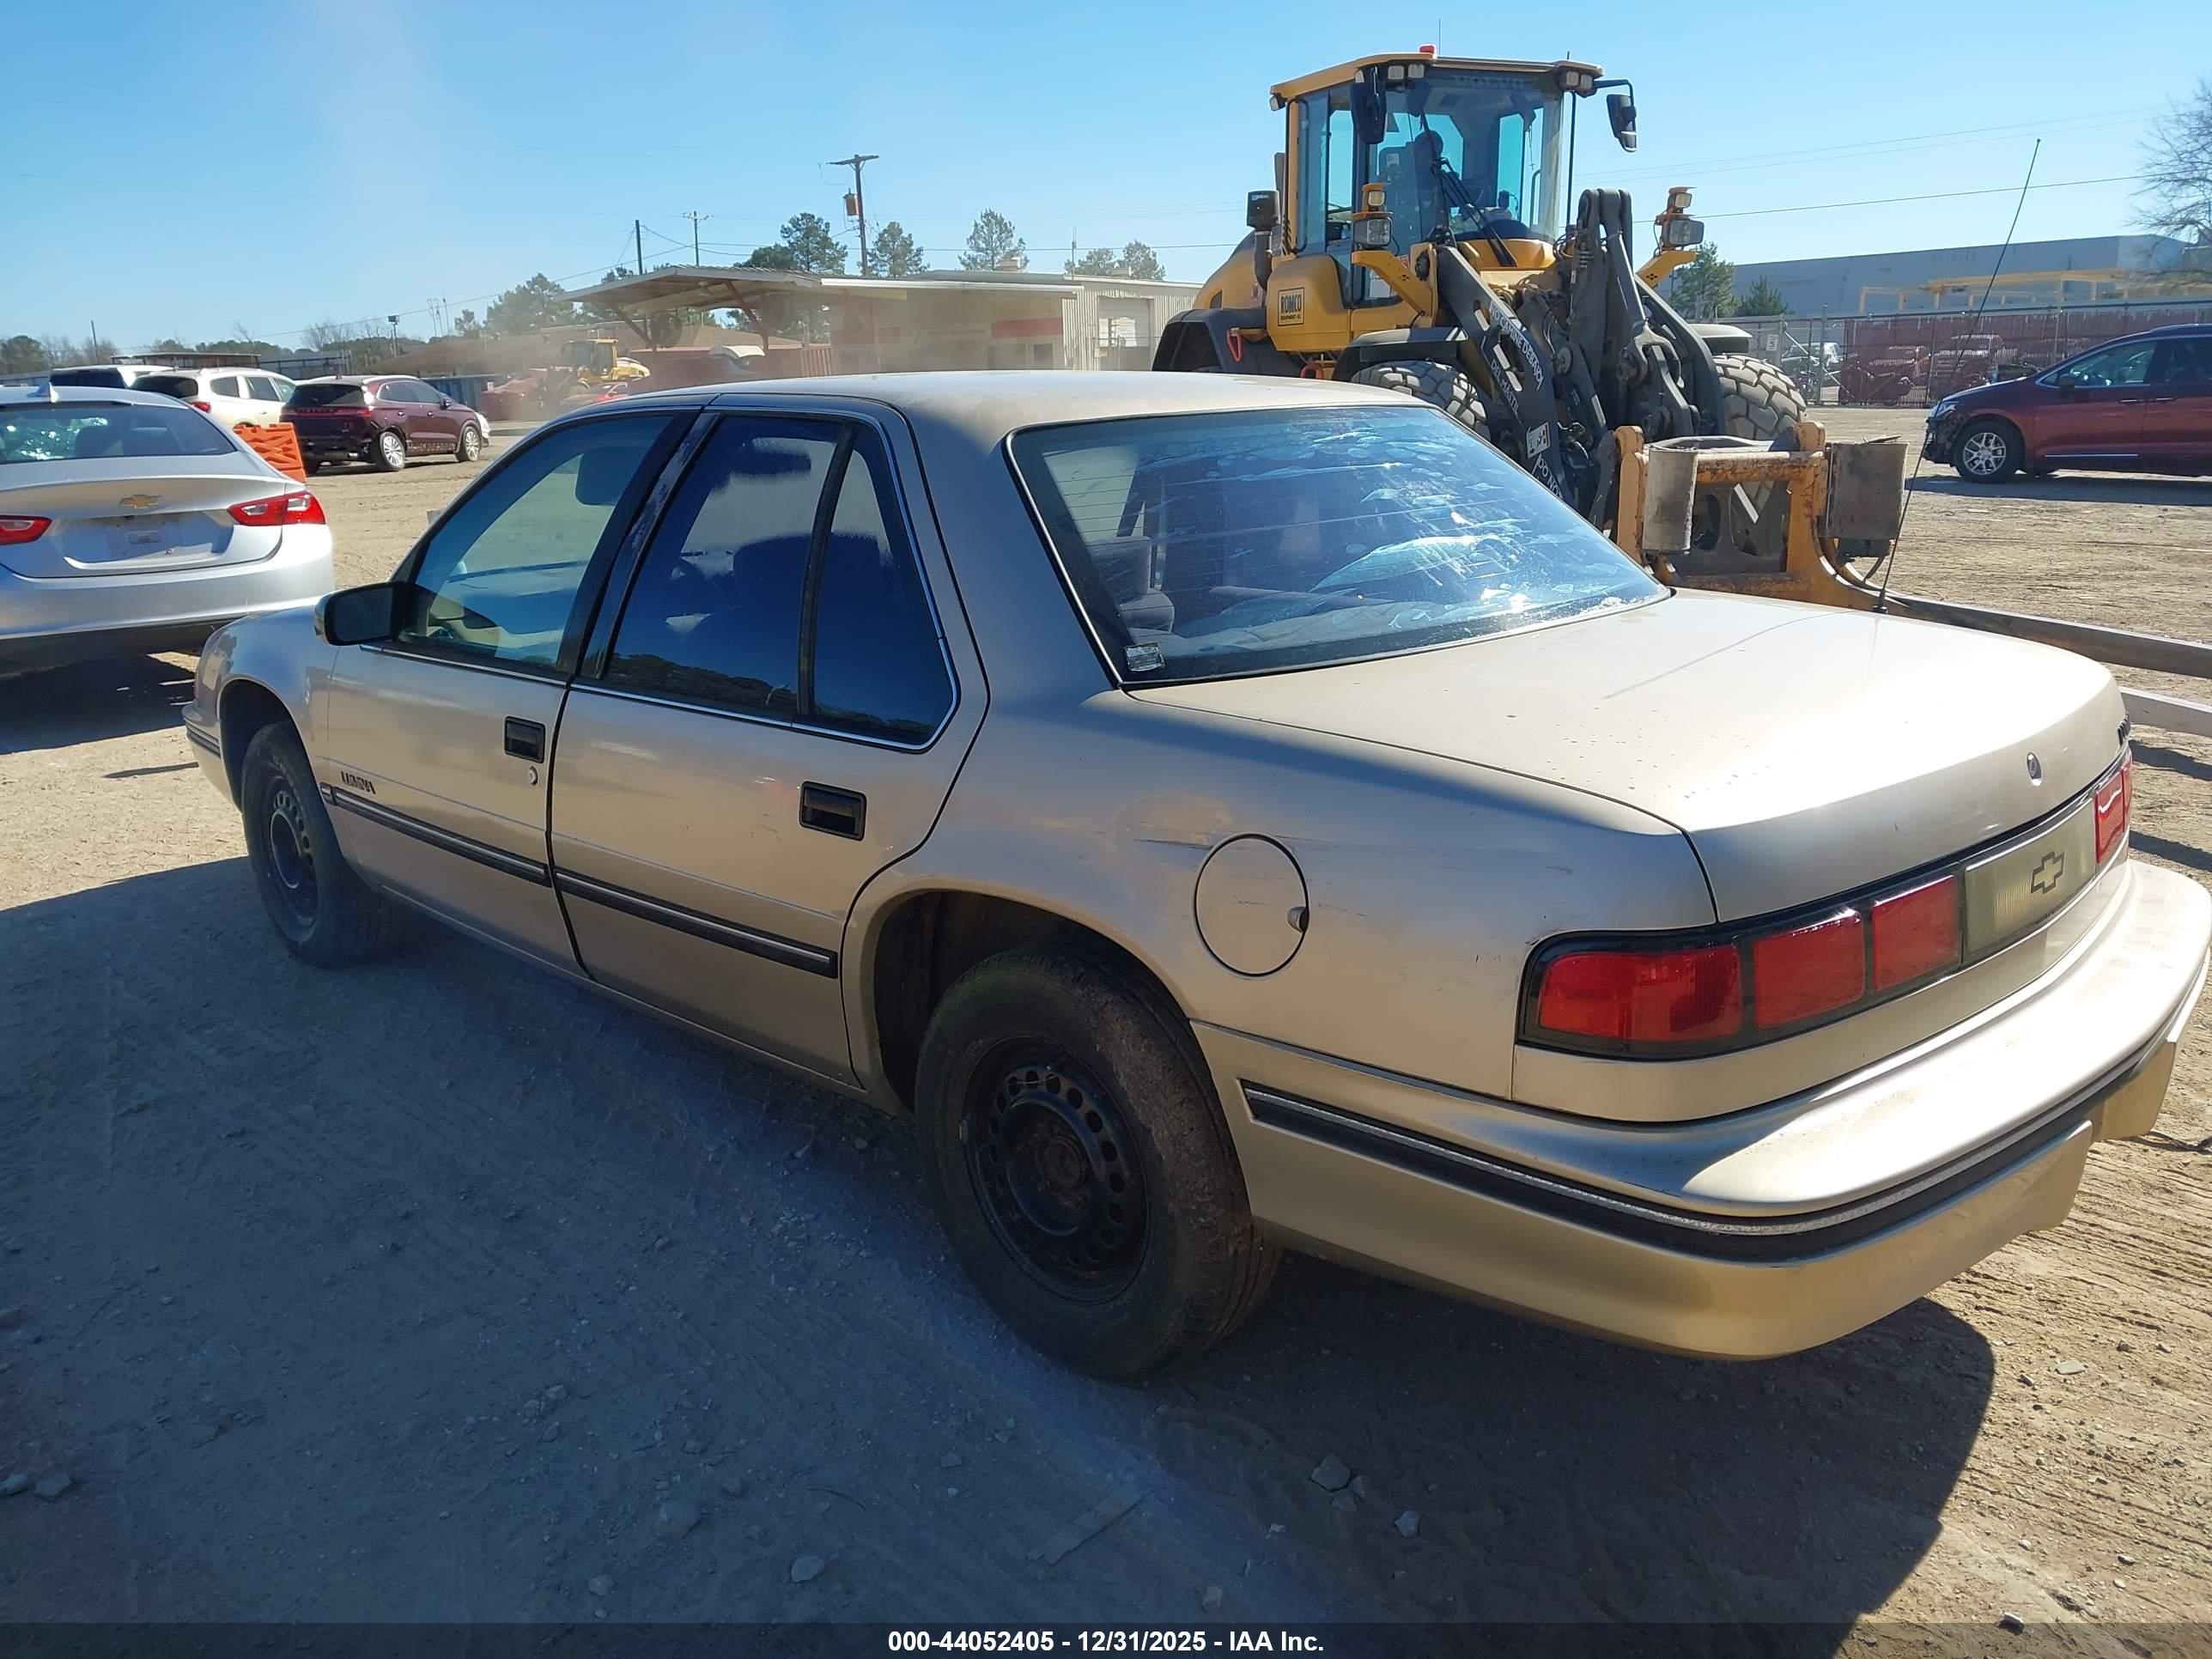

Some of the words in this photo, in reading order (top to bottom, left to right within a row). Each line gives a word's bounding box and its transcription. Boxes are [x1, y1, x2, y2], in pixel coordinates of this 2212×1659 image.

[1280, 294, 1302, 314] ROMCO
[1491, 306, 1500, 321] NO
[1500, 318, 1523, 349] CAMINE
[1491, 359, 1502, 382] DEL
